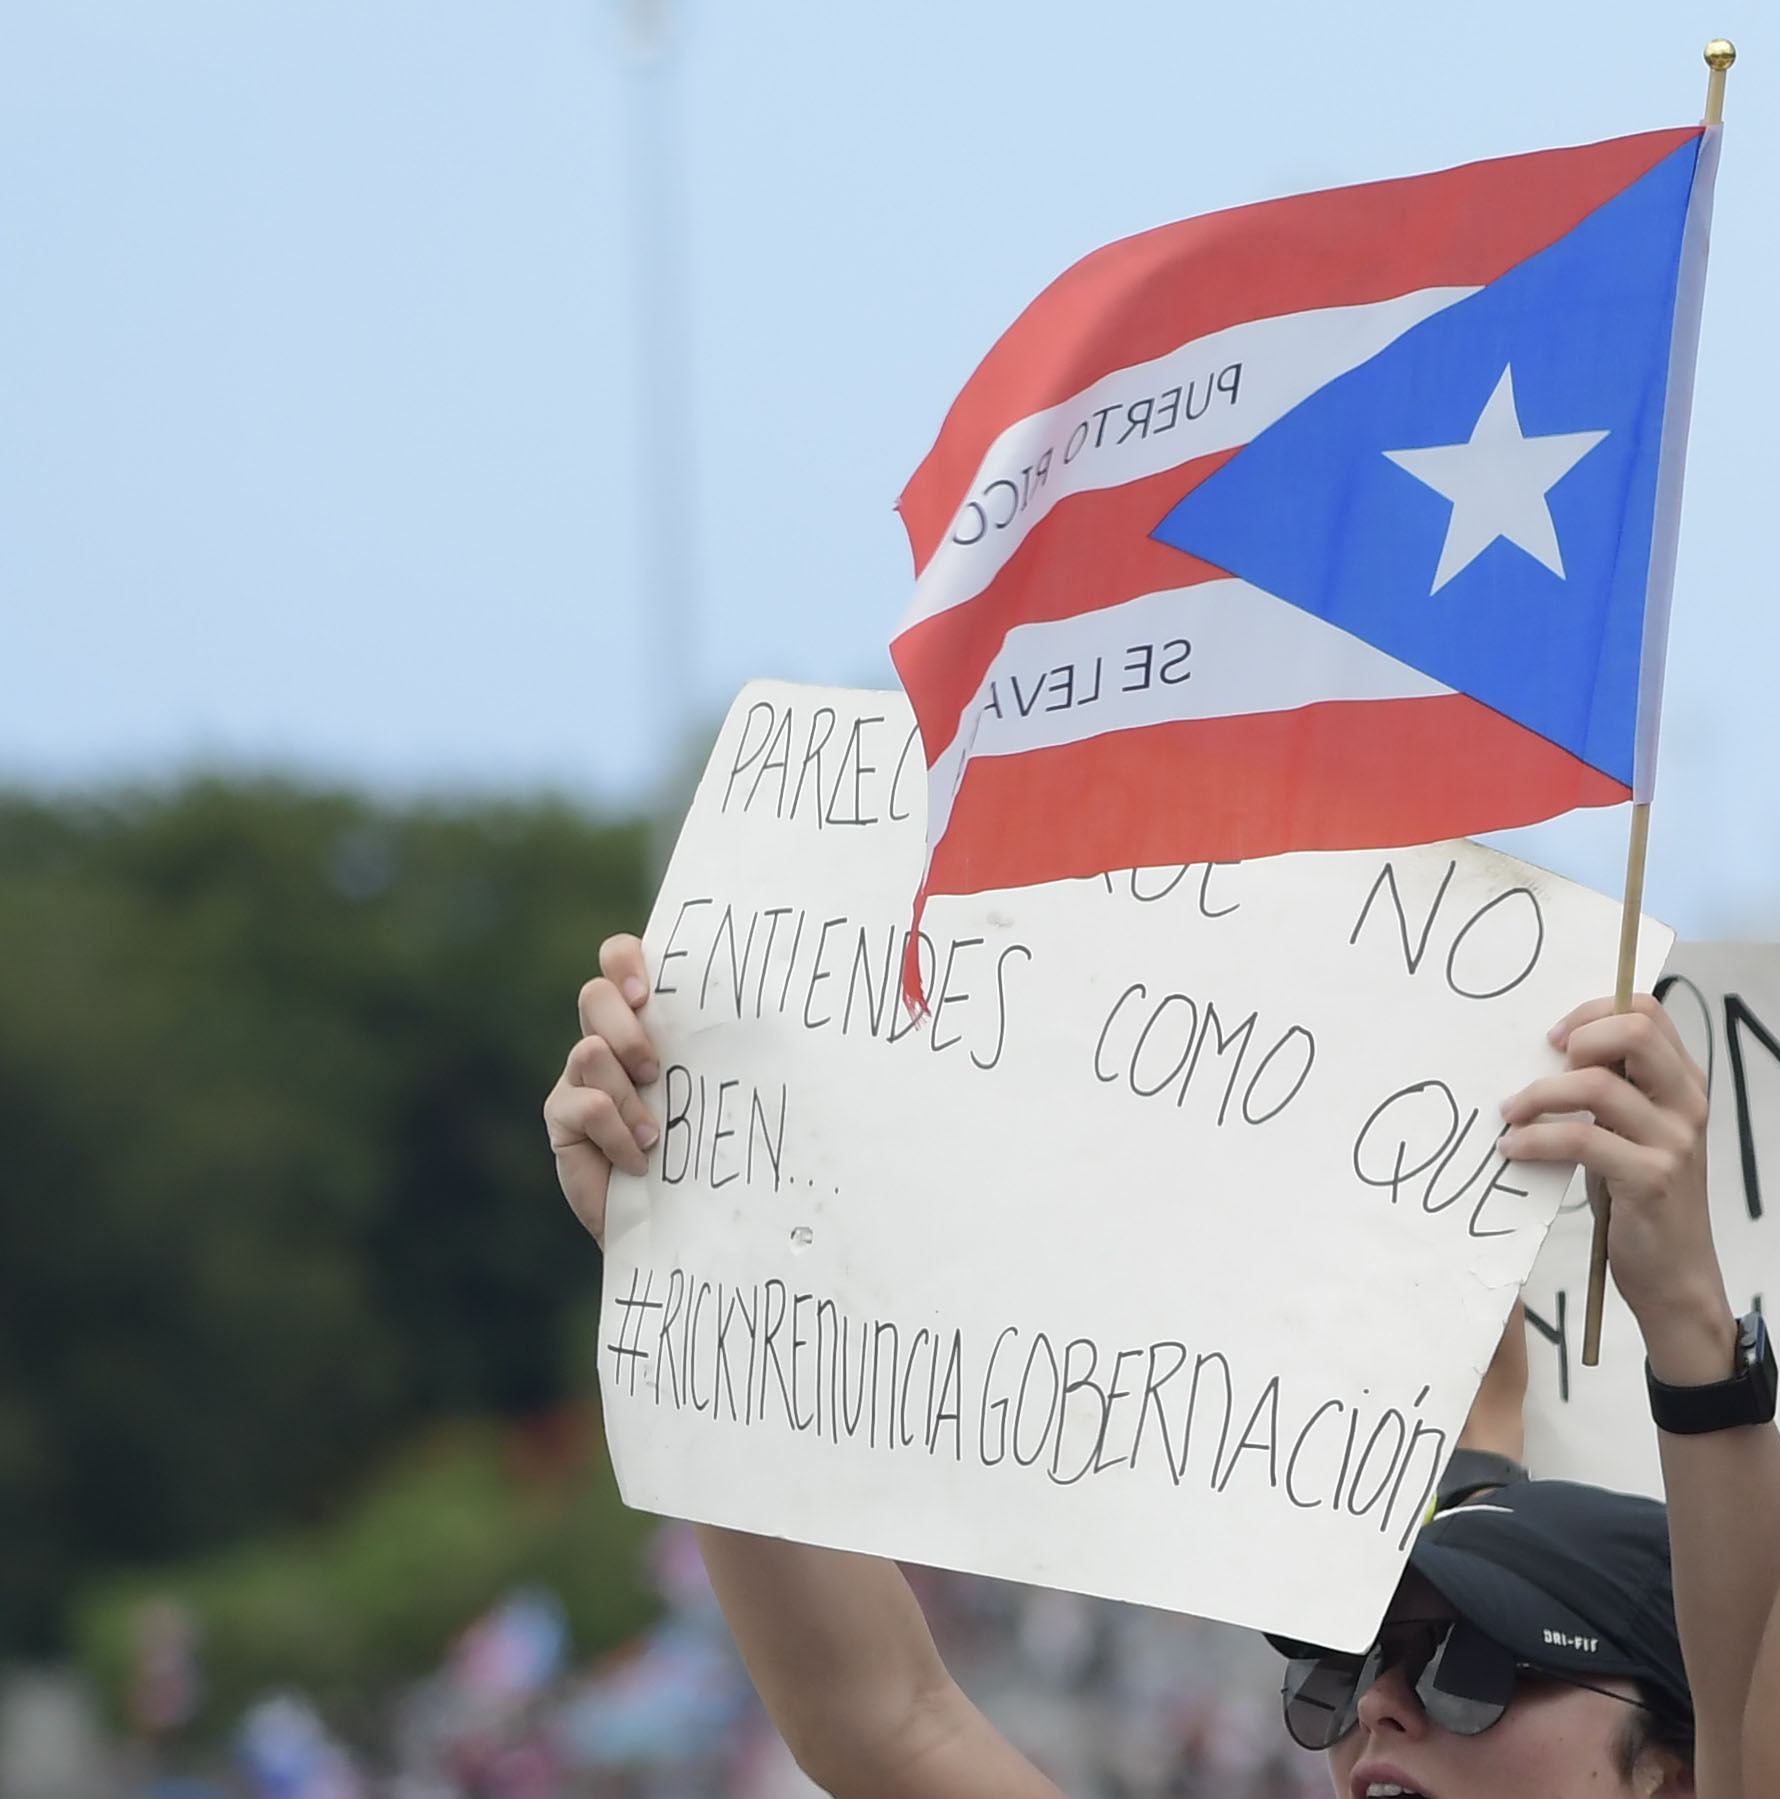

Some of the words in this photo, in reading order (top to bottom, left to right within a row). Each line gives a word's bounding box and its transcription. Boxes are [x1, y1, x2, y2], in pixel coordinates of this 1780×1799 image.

[654, 898, 1033, 1071] ENTIENDES
[1094, 983, 1317, 1126] COMO
[1353, 1079, 1529, 1238] QUE
